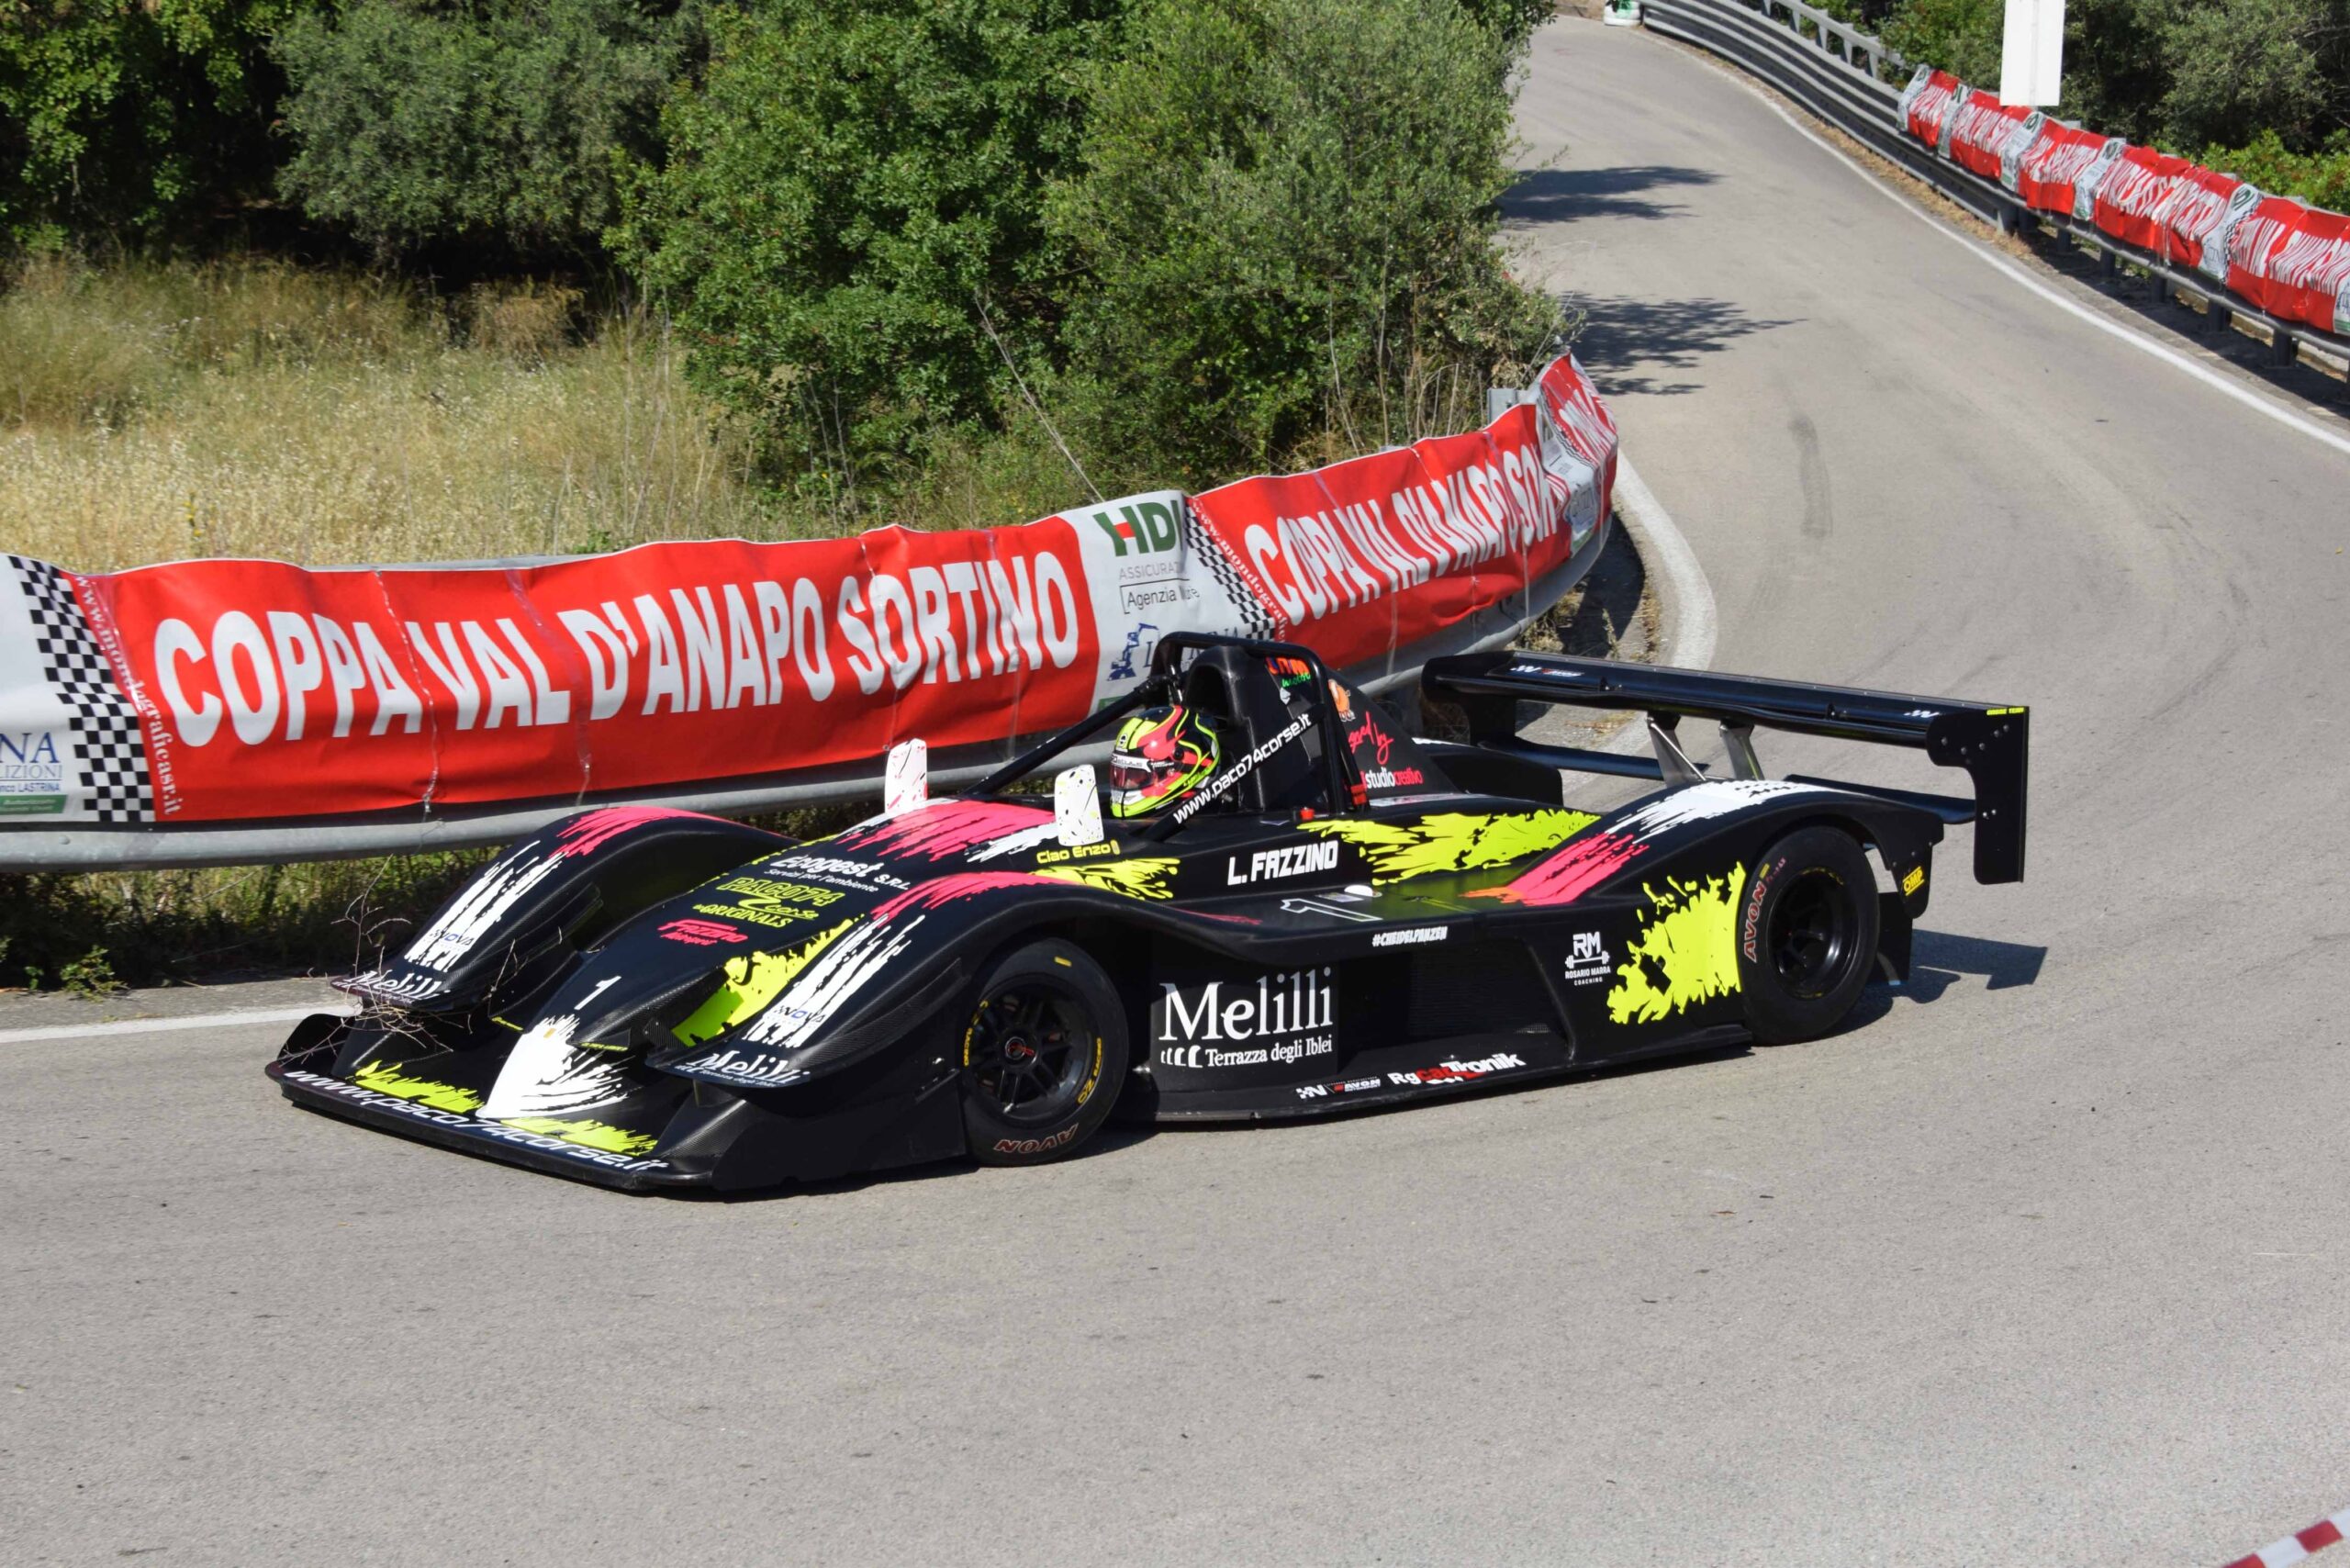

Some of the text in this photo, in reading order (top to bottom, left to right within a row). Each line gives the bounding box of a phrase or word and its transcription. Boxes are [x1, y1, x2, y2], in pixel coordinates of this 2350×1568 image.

[1092, 500, 1183, 557] HDI
[1244, 510, 1380, 626] COPPA
[1334, 499, 1430, 593] VAL
[1127, 588, 1177, 610] Agenzia
[154, 552, 1079, 747] COPPA VAL D'ANAPO SORTINO
[1173, 712, 1312, 824] www.paco74corse.it
[770, 856, 884, 878] Ecogest
[1072, 843, 1111, 858] Enzo
[1227, 840, 1338, 885] L. FAZZINO
[800, 871, 822, 881] per
[1903, 868, 1924, 892] OMP
[1744, 880, 1767, 963] AVON
[1572, 931, 1601, 959] RM
[1565, 966, 1611, 980] ROSARIO MARRA
[1574, 977, 1603, 986] COACHING
[575, 976, 621, 1011] 1
[1158, 967, 1333, 1040] Melilli
[1205, 1034, 1333, 1067] Terrazza degli Iblei
[284, 1070, 669, 1170] www.paco74corse.it
[993, 1123, 1080, 1154] AVON
